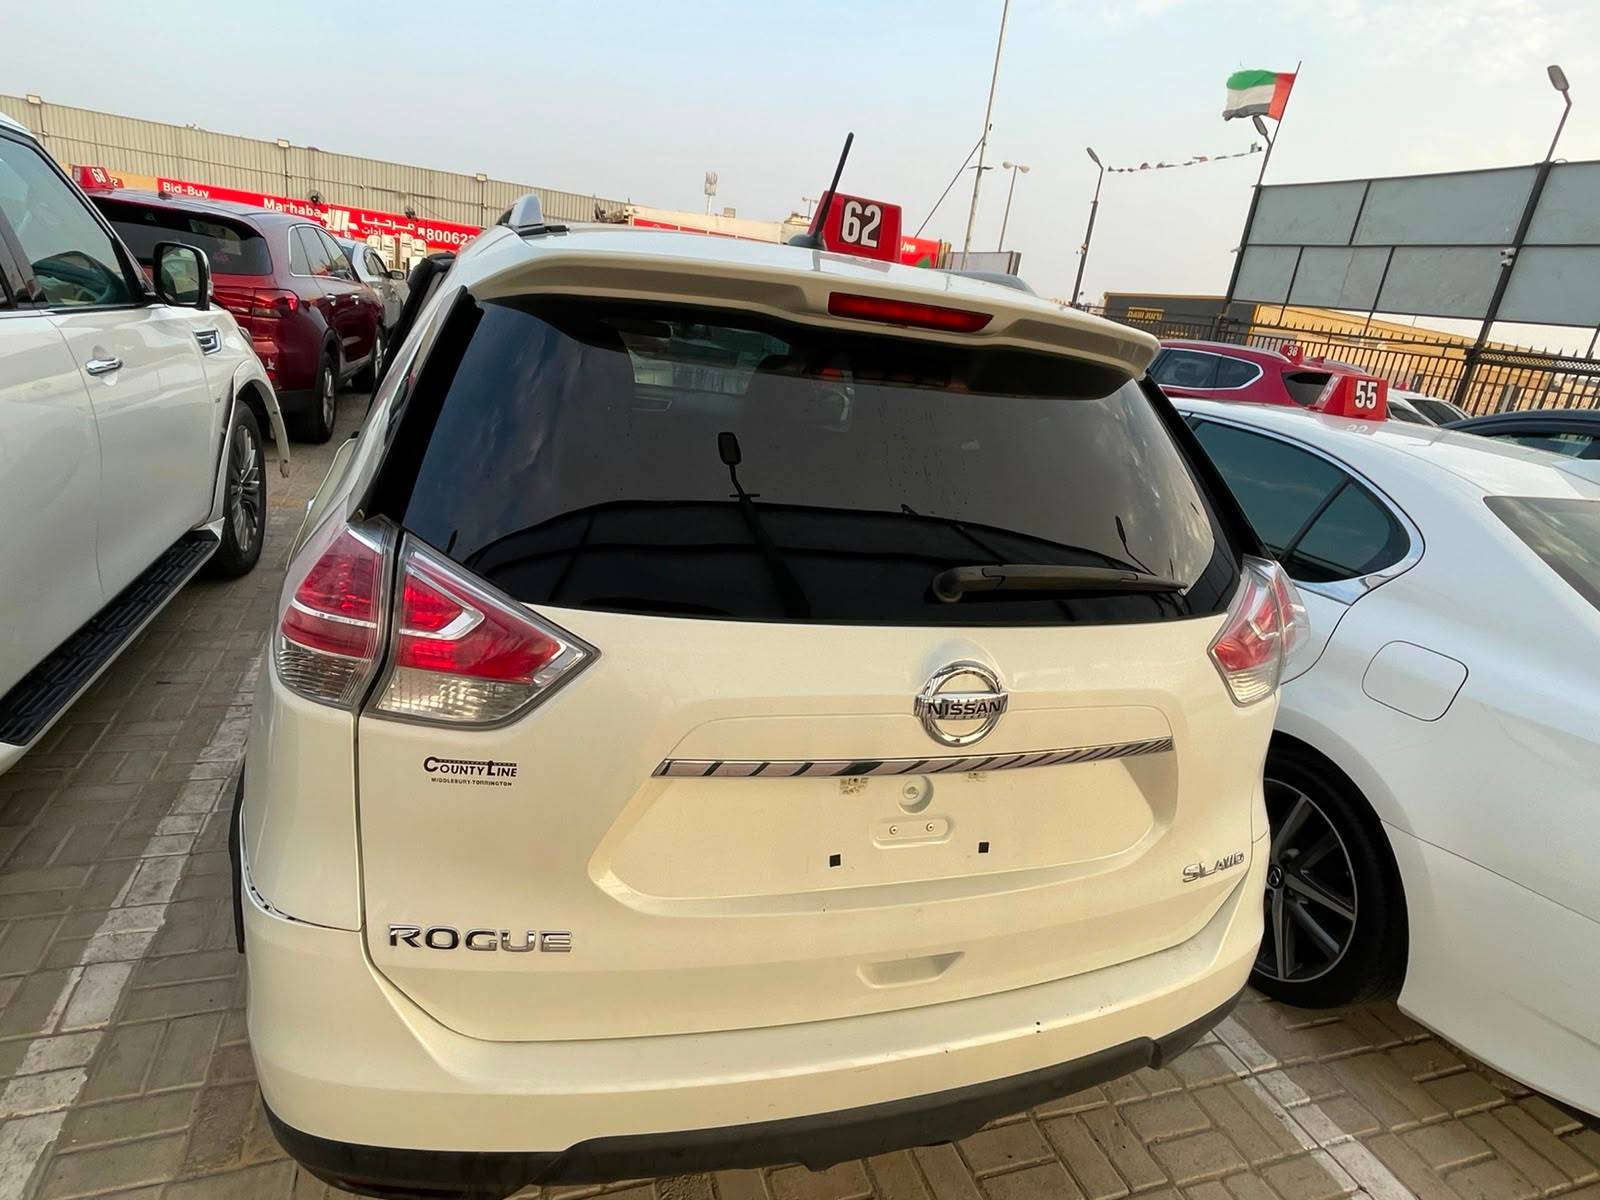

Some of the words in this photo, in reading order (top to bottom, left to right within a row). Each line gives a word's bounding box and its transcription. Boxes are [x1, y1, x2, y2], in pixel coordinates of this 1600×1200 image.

[91, 167, 107, 184] 68
[162, 181, 209, 199] Bid-Buy
[263, 197, 322, 218] Marhaba
[361, 213, 416, 231] مرحبا
[841, 200, 881, 248] 62
[1354, 380, 1378, 410] 55
[927, 700, 1001, 716] NISSAN
[1182, 862, 1216, 883] SL
[388, 924, 573, 953] ROGUE
